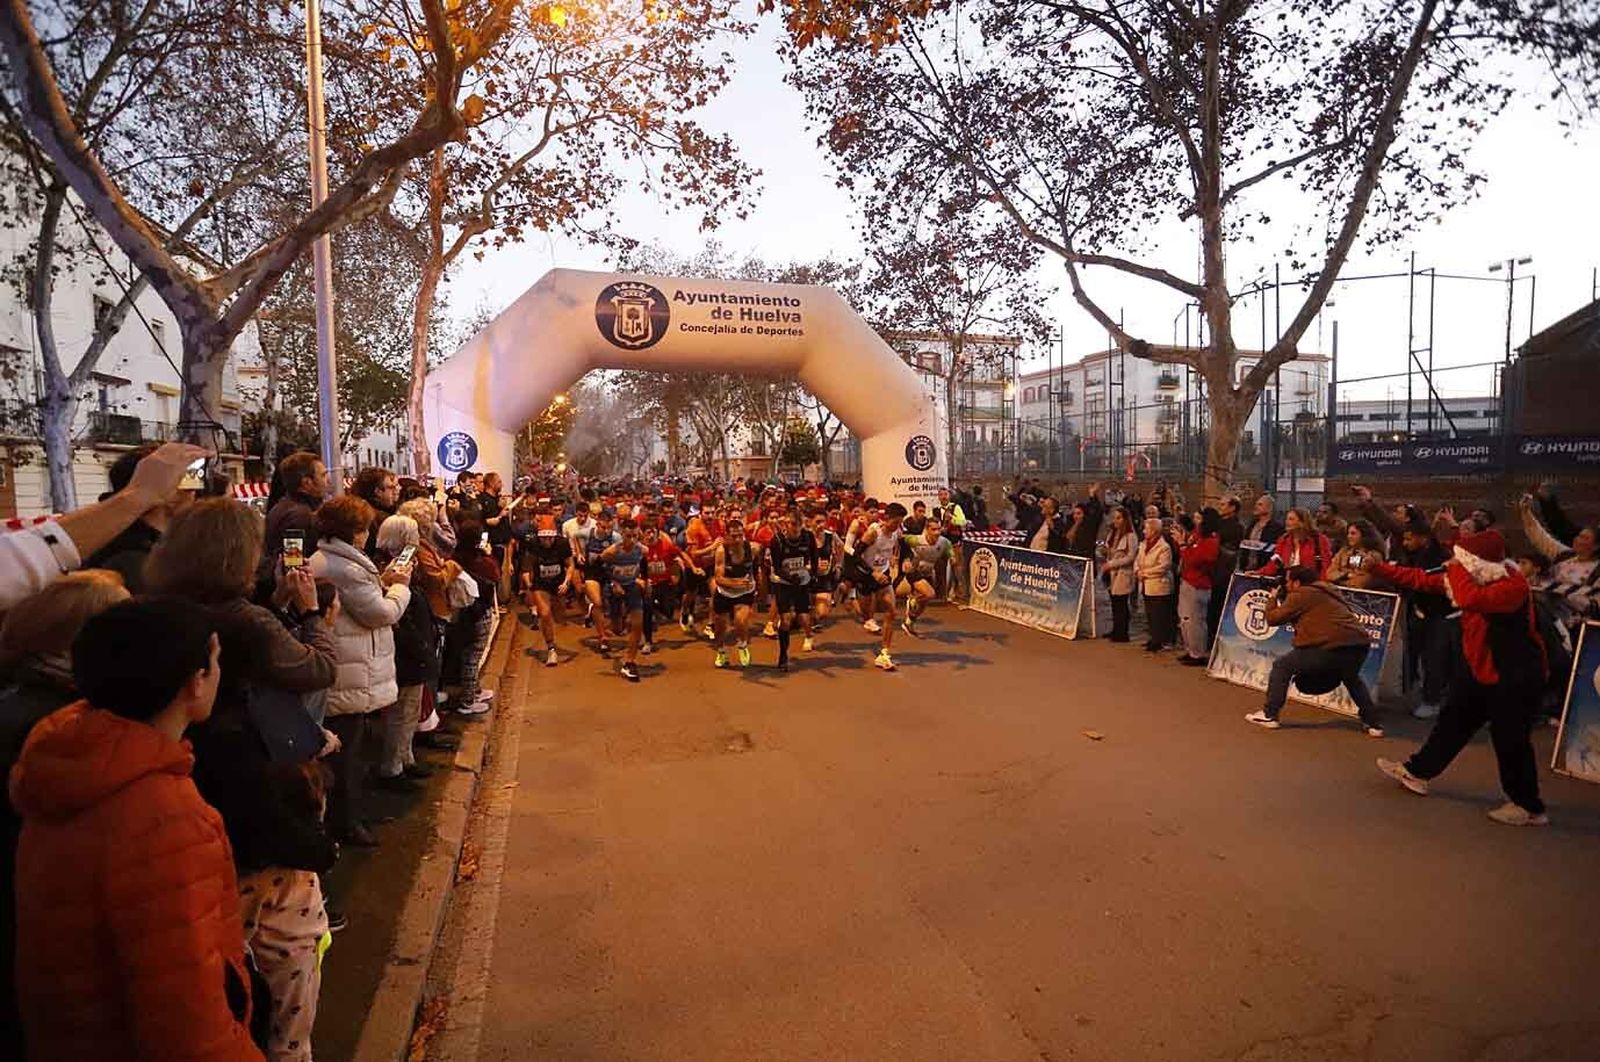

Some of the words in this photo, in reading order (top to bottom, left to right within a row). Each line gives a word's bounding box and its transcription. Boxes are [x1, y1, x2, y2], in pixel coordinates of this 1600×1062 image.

[673, 290, 801, 307] Ayuntamiento
[711, 306, 733, 320] de
[740, 307, 802, 323] Huelva
[740, 325, 753, 334] de
[757, 325, 804, 337] Deportes
[1357, 449, 1401, 459] HYUNDAI
[1435, 446, 1489, 456] HYUNDAI
[1547, 441, 1600, 453] HYUND
[1000, 557, 1060, 578] Ayuntamiento
[1010, 572, 1023, 583] de
[1024, 574, 1058, 591] Huelva
